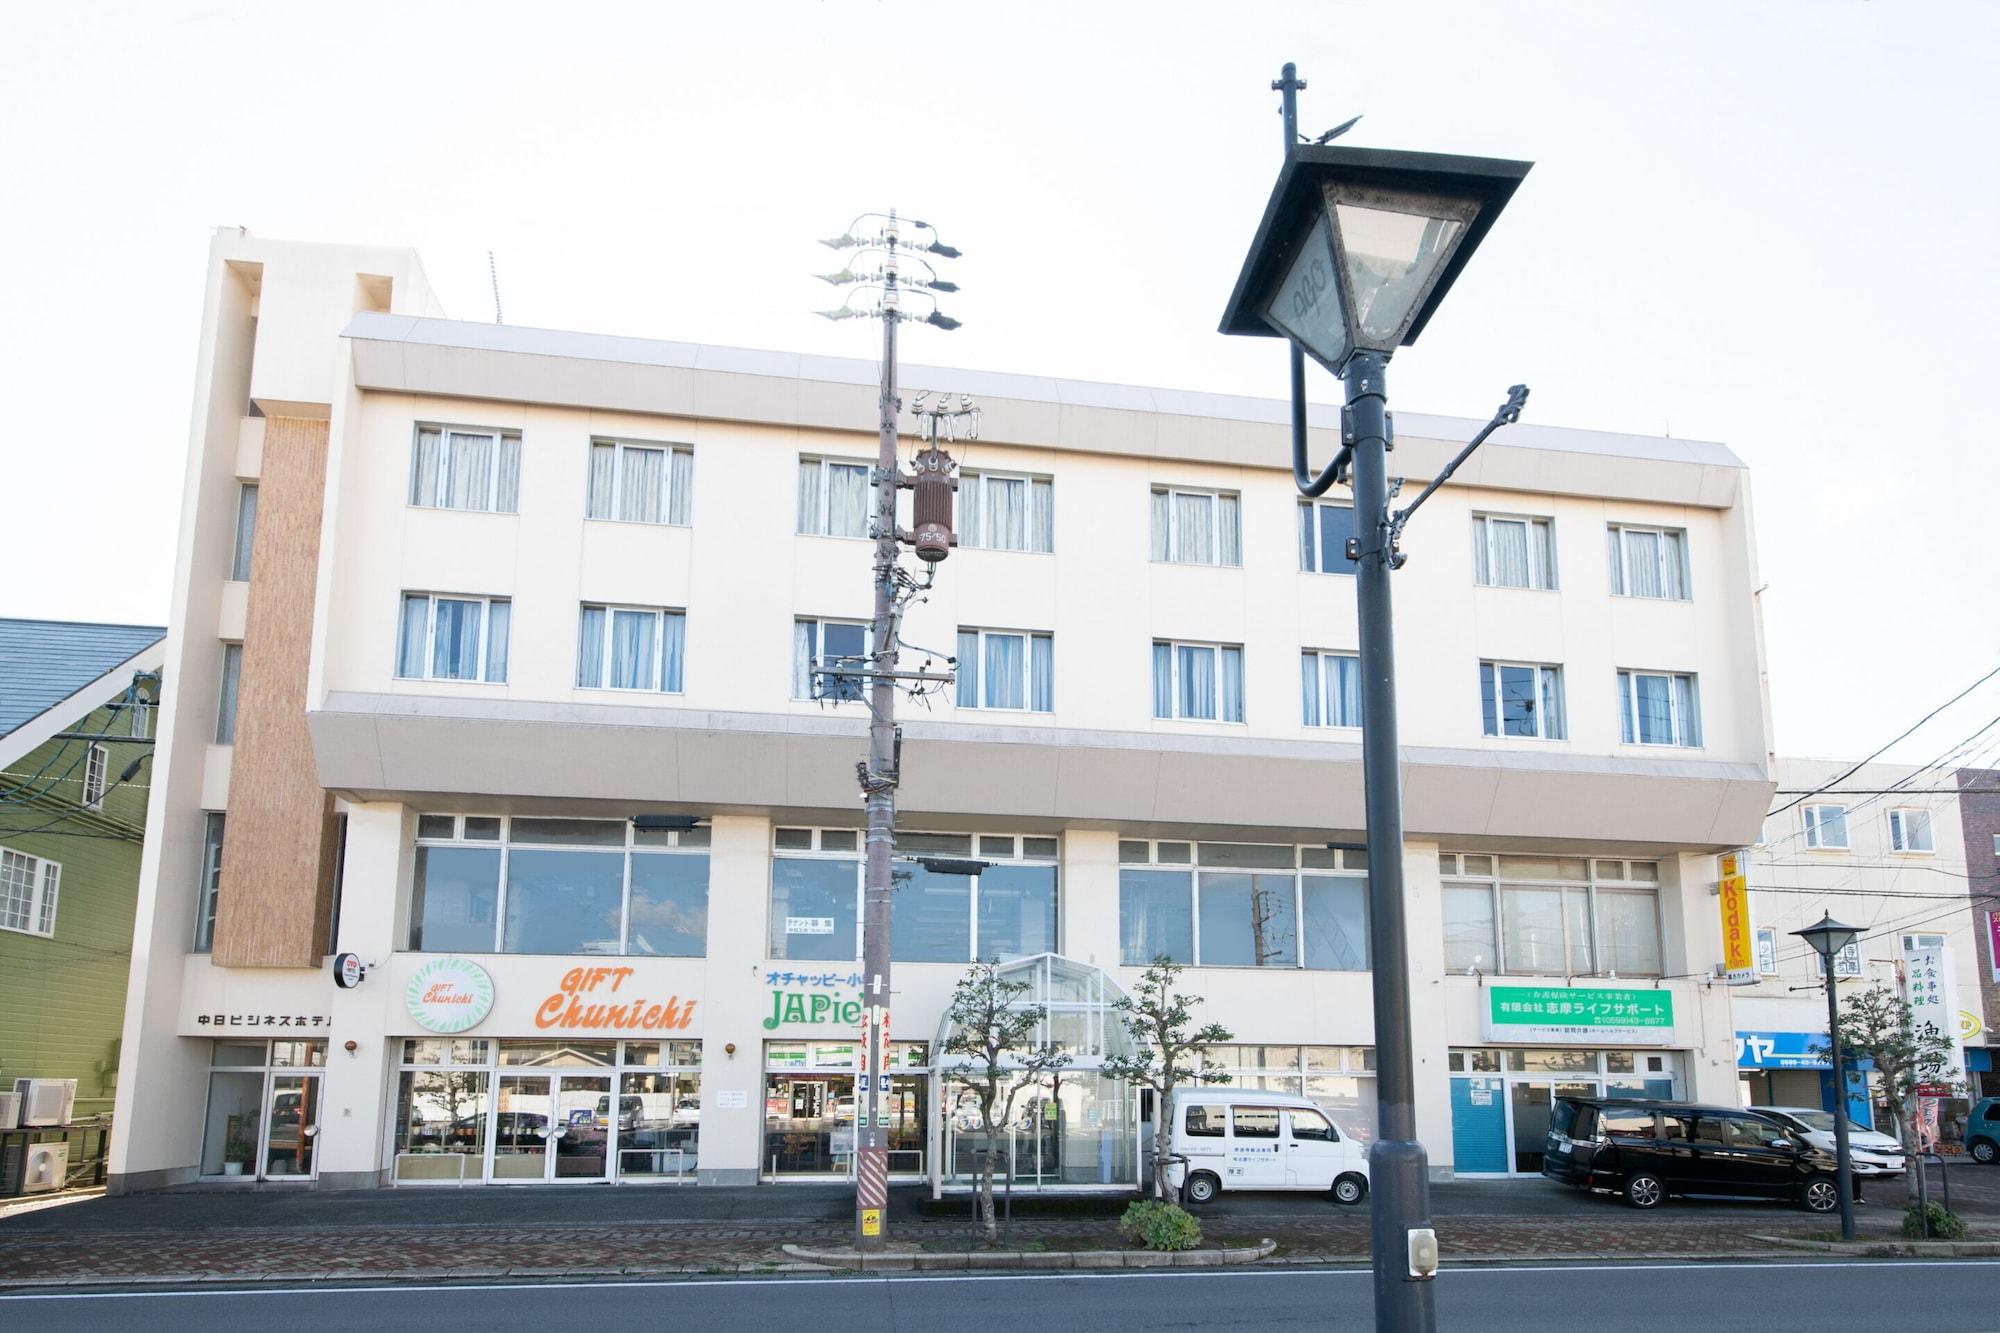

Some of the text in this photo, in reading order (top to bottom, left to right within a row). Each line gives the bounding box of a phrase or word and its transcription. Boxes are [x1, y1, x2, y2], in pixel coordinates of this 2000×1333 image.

[1723, 881, 1742, 958] Kodak
[431, 983, 454, 993] GIFT
[560, 967, 634, 996] GIFT
[1911, 957, 1926, 1007] 一品料理
[1924, 954, 1940, 1006] お食事処
[422, 991, 475, 1004] Chunichi
[535, 993, 697, 1030] Chunichi
[1500, 1002, 1665, 1016] 有限会社 志摩ライフサポート
